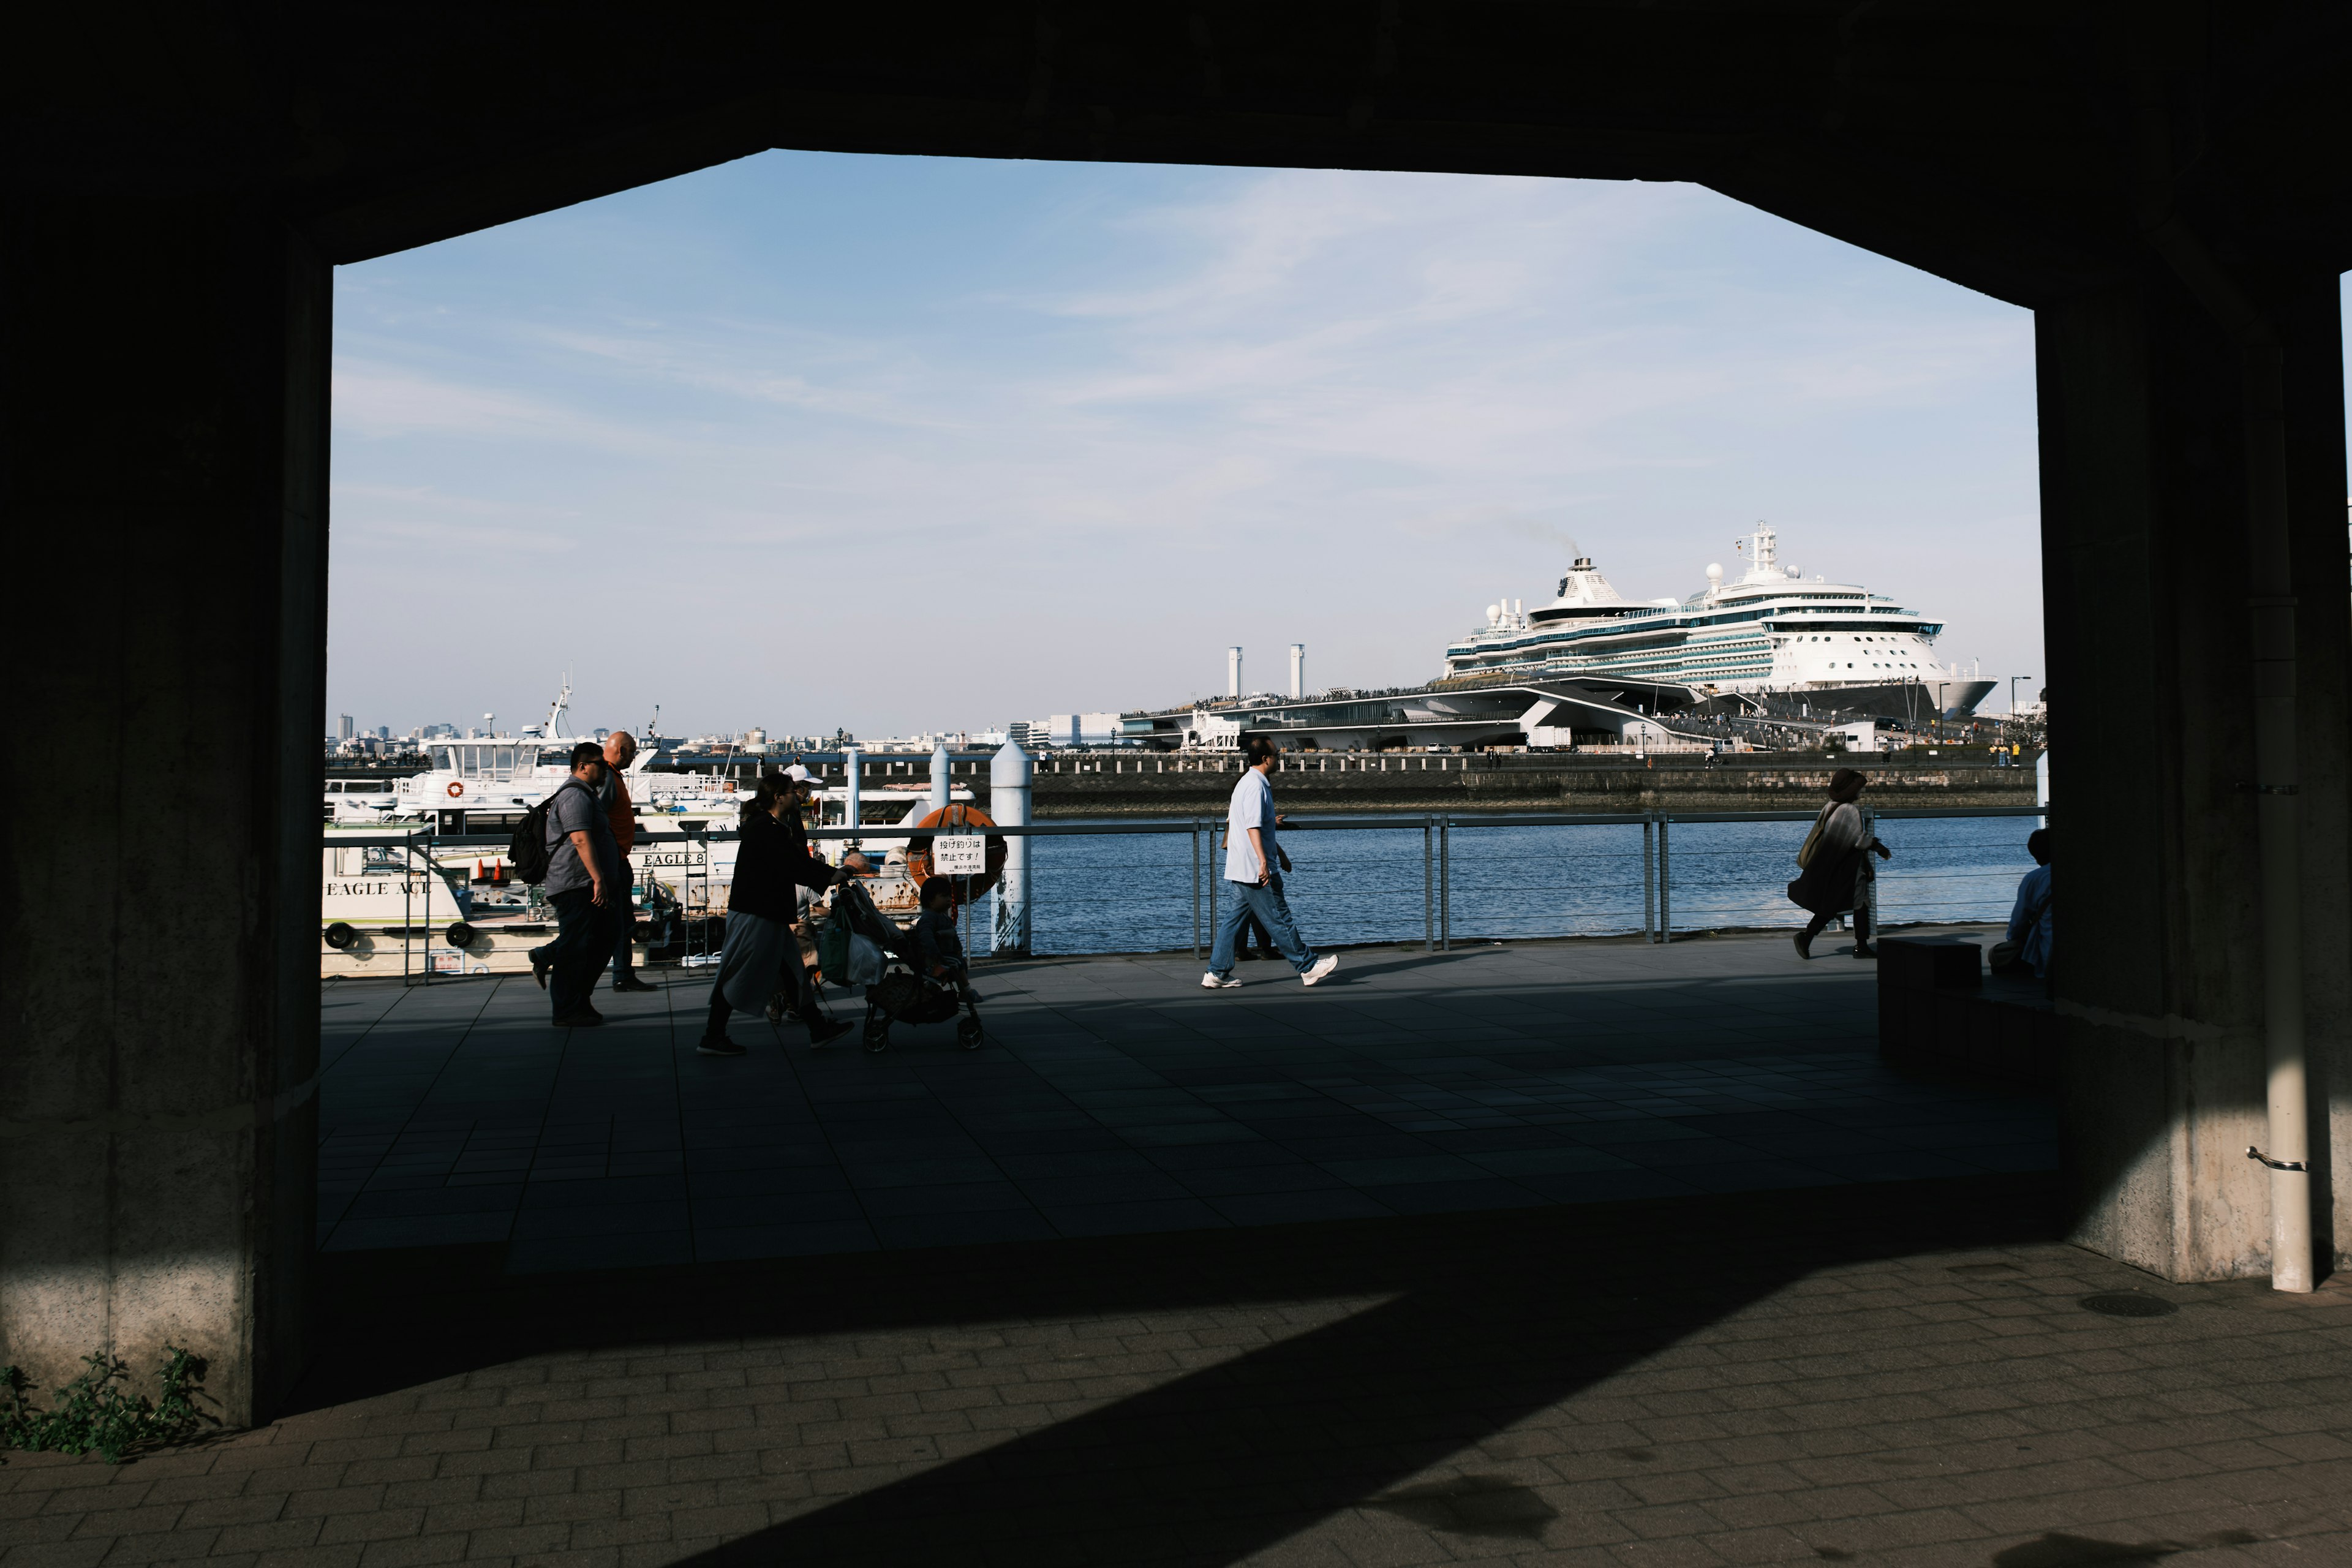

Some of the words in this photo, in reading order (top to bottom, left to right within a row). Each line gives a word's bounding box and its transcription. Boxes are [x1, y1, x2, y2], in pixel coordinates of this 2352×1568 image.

[940, 840, 981, 850] 投げ釣りは
[644, 854, 692, 864] EAGLE
[696, 854, 704, 863] 8
[327, 883, 388, 895] EAGLE
